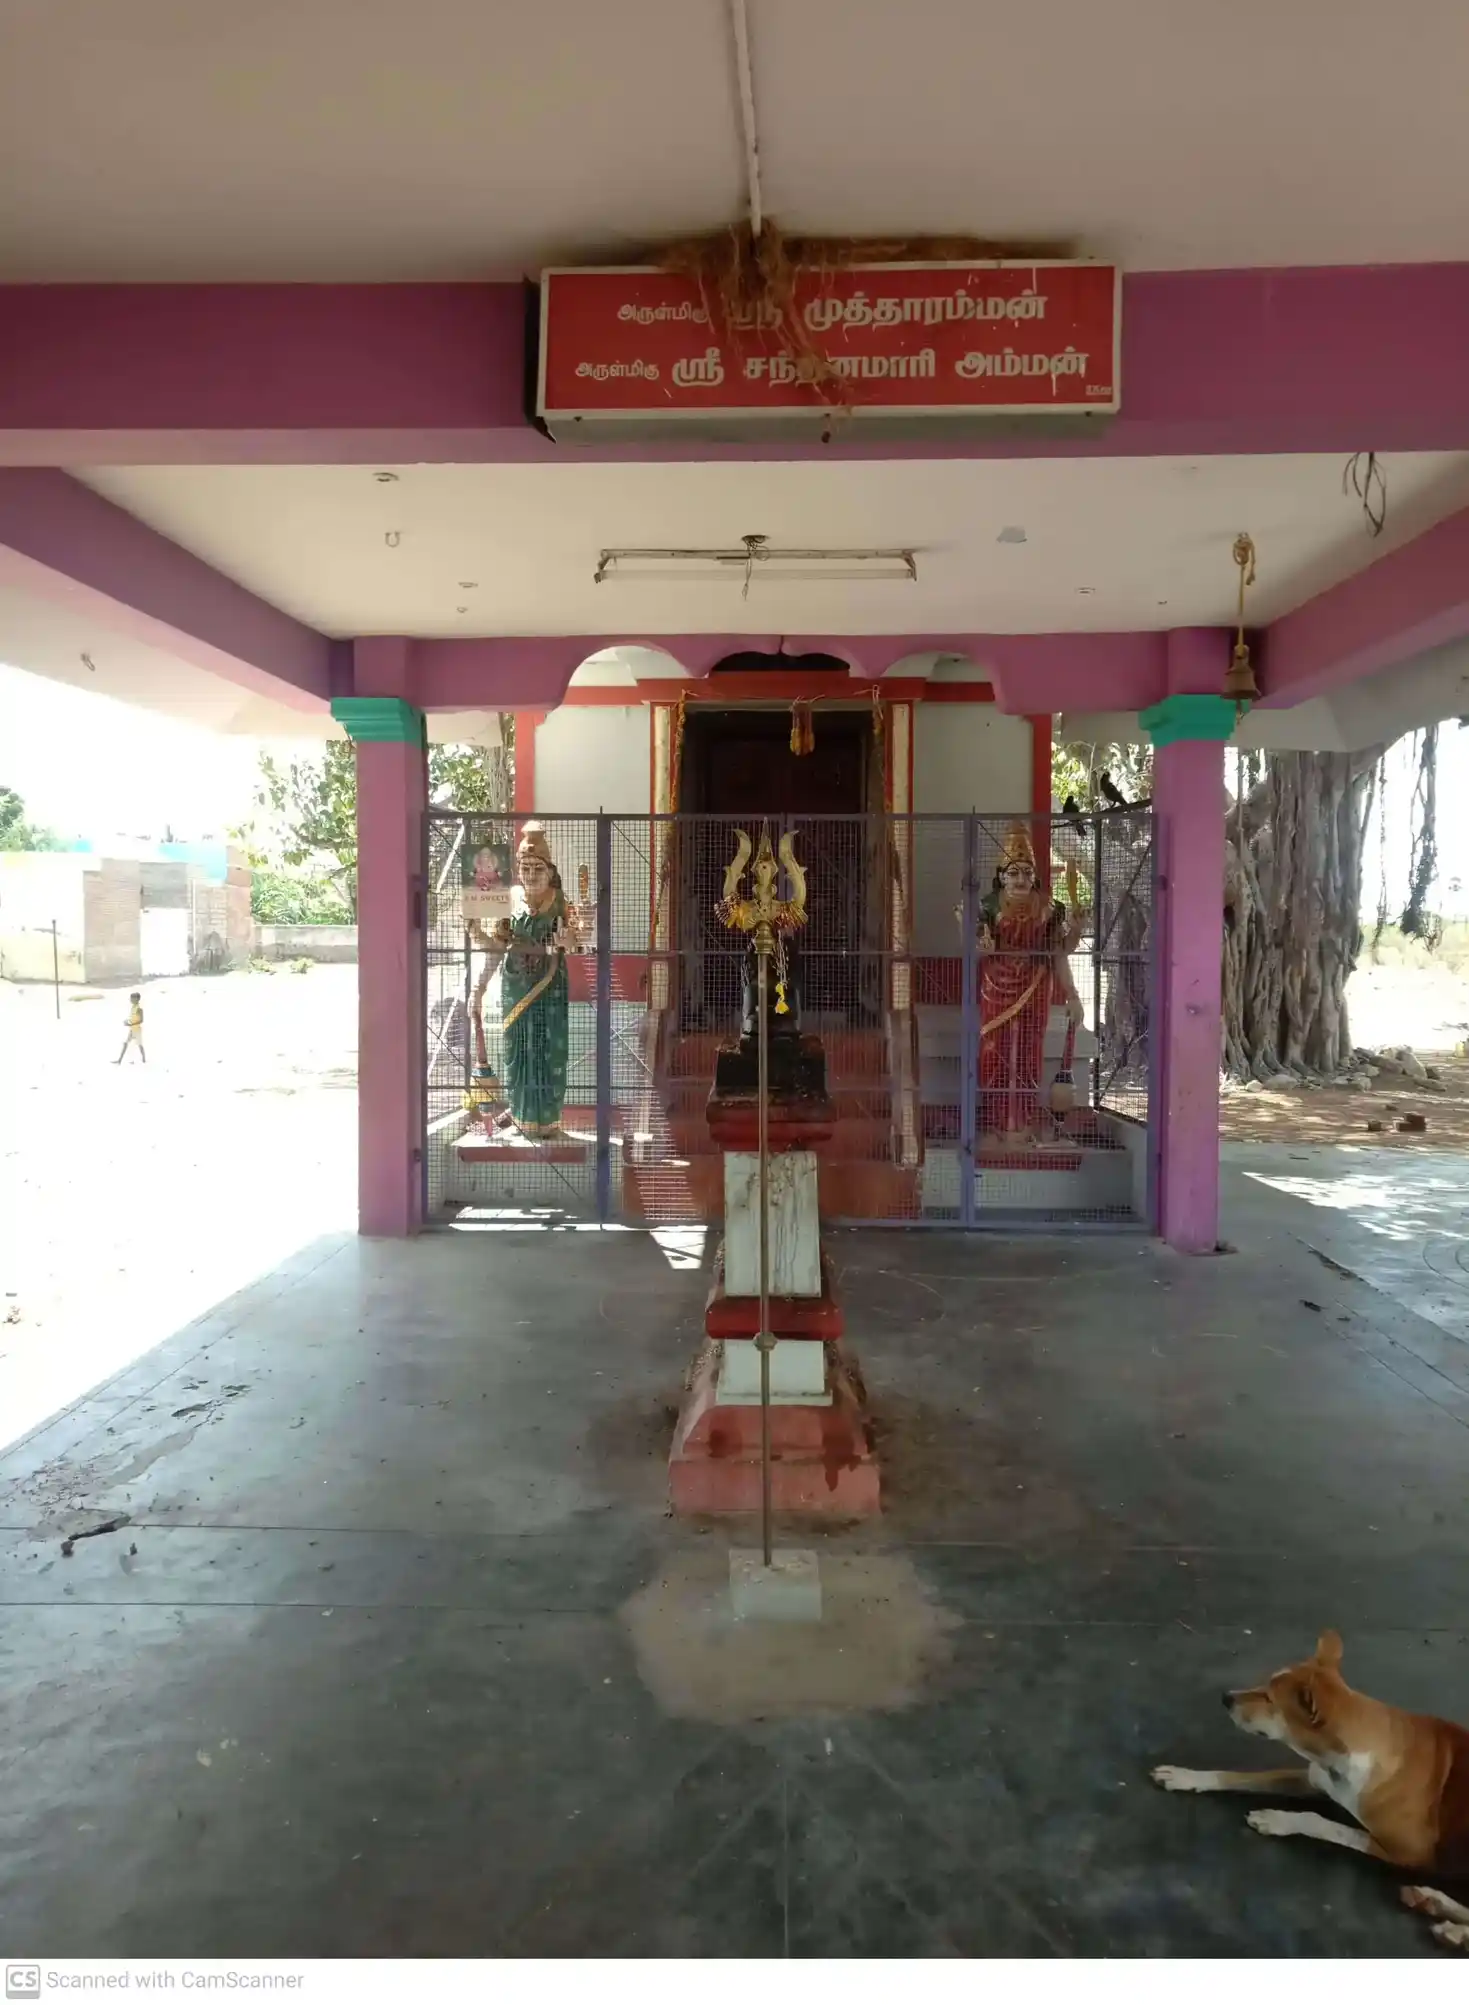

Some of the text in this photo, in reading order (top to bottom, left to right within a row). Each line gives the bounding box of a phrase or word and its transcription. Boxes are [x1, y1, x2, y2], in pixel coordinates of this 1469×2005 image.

[617, 302, 709, 324] அருள்மிகு
[803, 288, 1048, 333] முத்தாரம்மன்
[575, 360, 660, 381] அருள்மிகு
[672, 347, 725, 387] ஸ்ரீ
[955, 346, 1089, 379] அம்மன்
